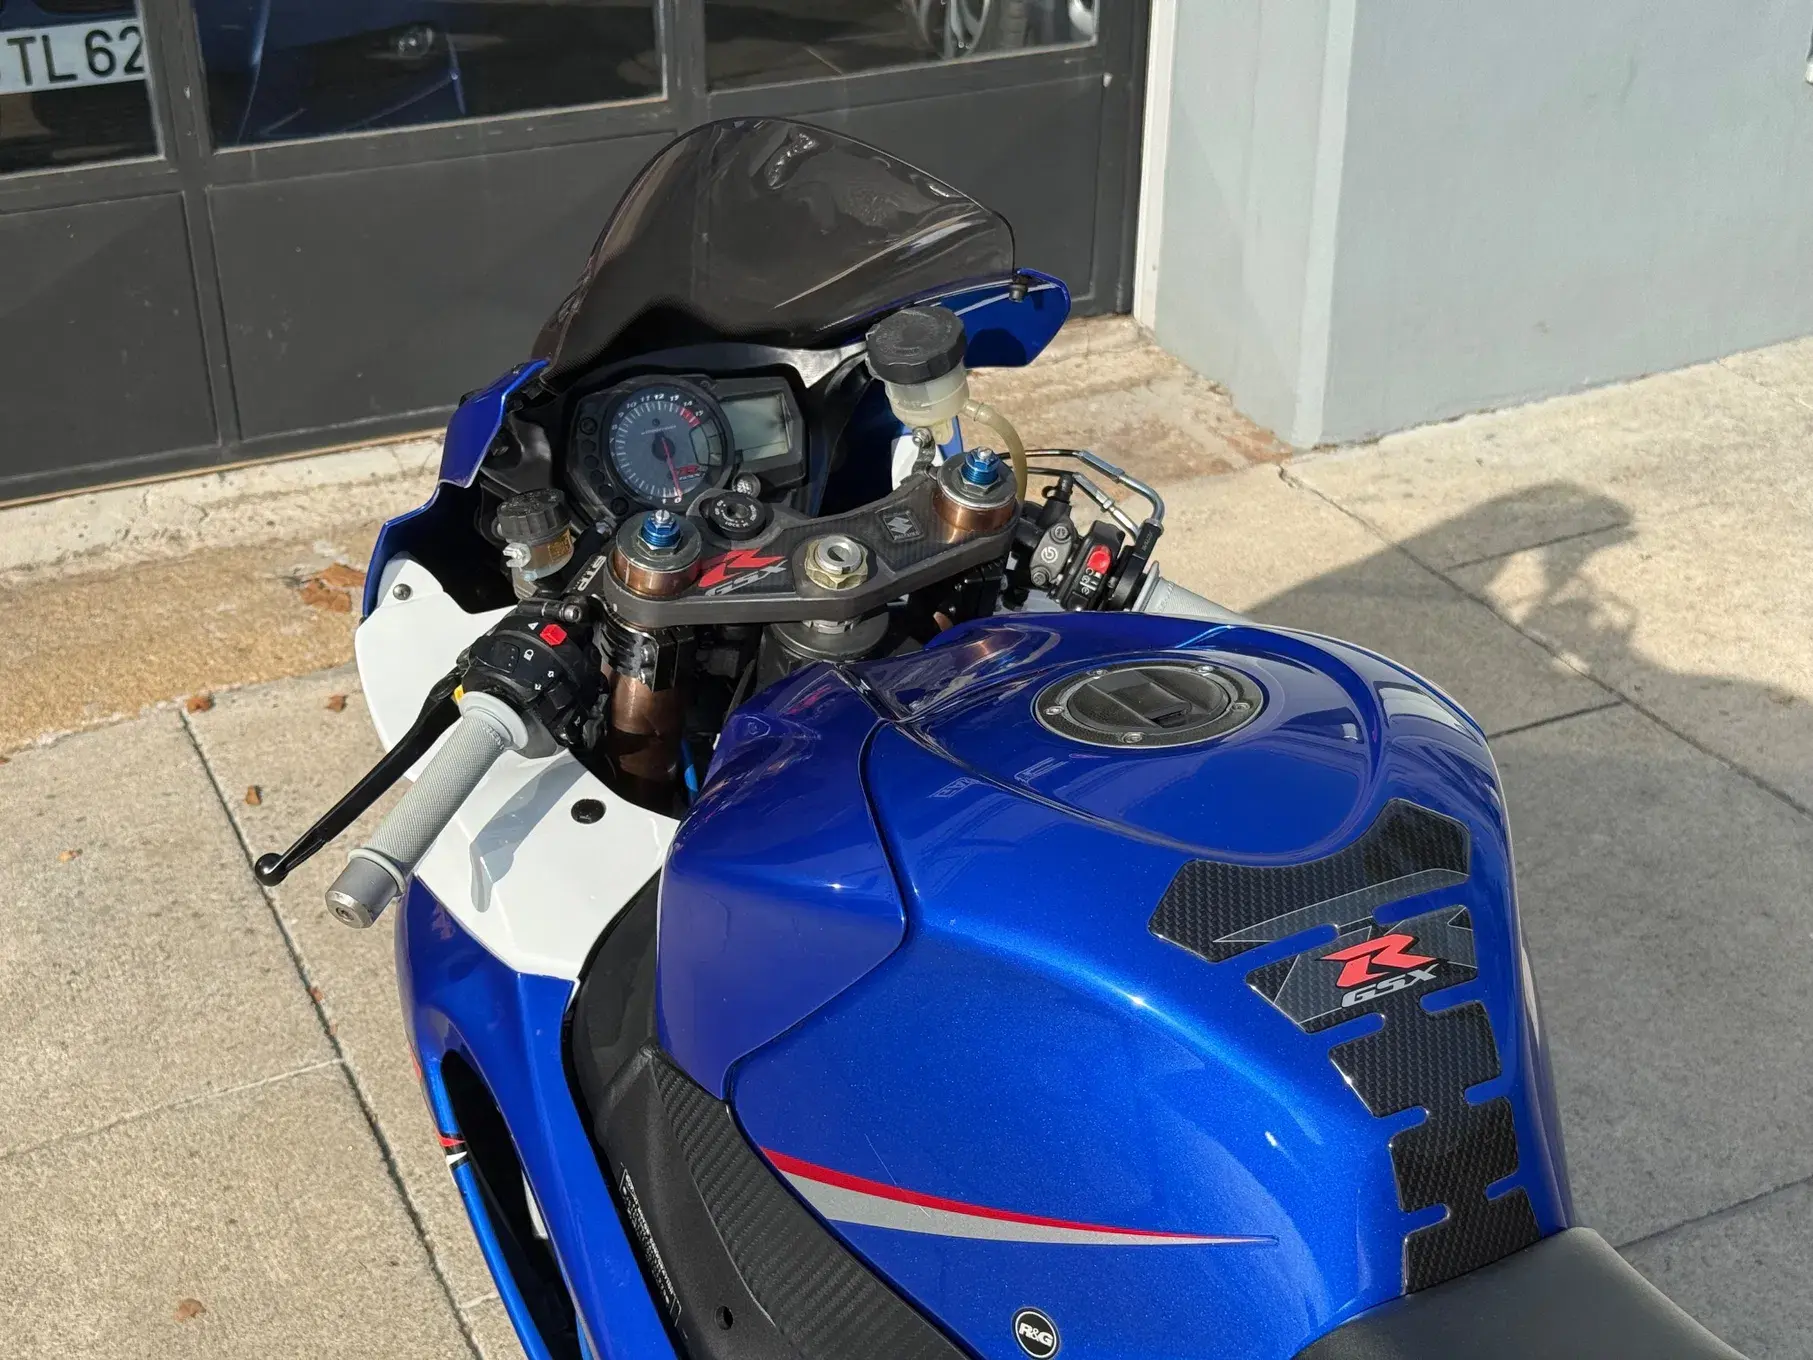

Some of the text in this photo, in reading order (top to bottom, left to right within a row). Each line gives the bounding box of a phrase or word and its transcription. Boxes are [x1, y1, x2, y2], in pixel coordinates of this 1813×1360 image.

[704, 559, 789, 597] GSX
[1341, 963, 1439, 1008] GSX
[1019, 1322, 1054, 1347] R&G
